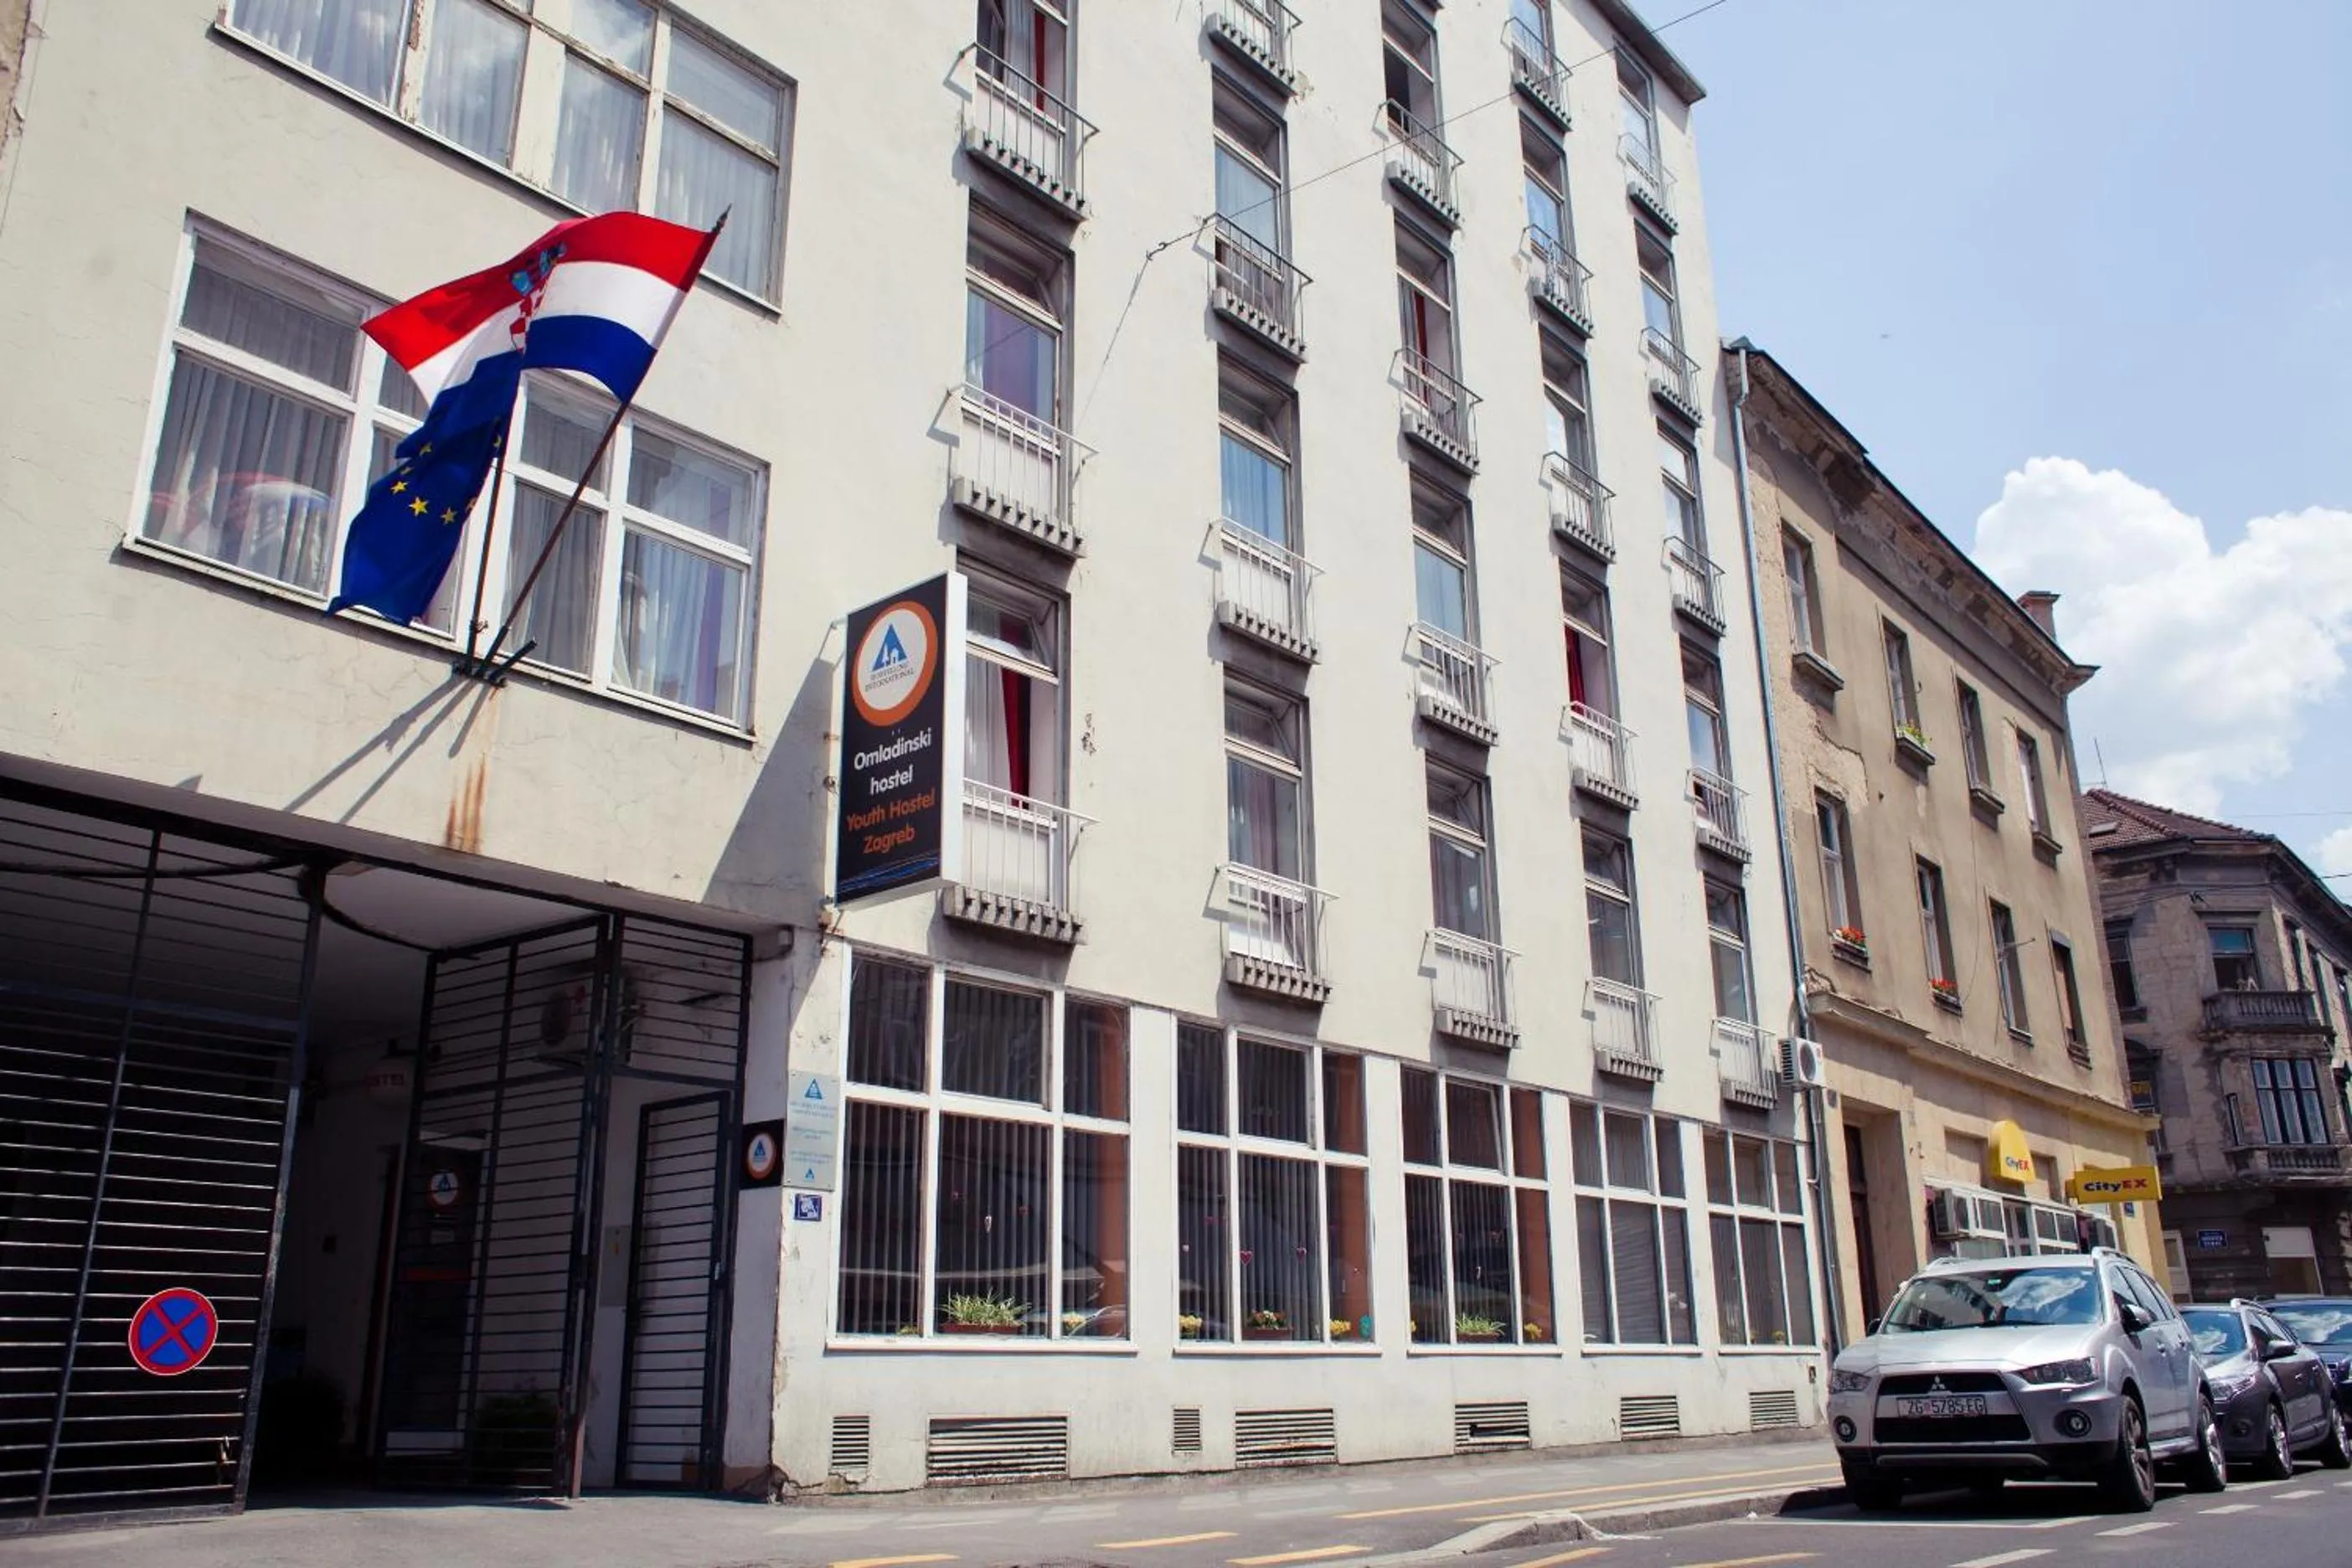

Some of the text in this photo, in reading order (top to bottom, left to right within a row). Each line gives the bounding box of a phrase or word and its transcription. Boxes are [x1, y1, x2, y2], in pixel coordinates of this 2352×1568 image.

[854, 727, 931, 770] Omladinski
[869, 764, 914, 795] hostel
[847, 787, 936, 832] Youth Hostel
[864, 823, 916, 854] Zagreb
[2084, 1179, 2148, 1193] CityEX
[1908, 1400, 1923, 1414] ZG
